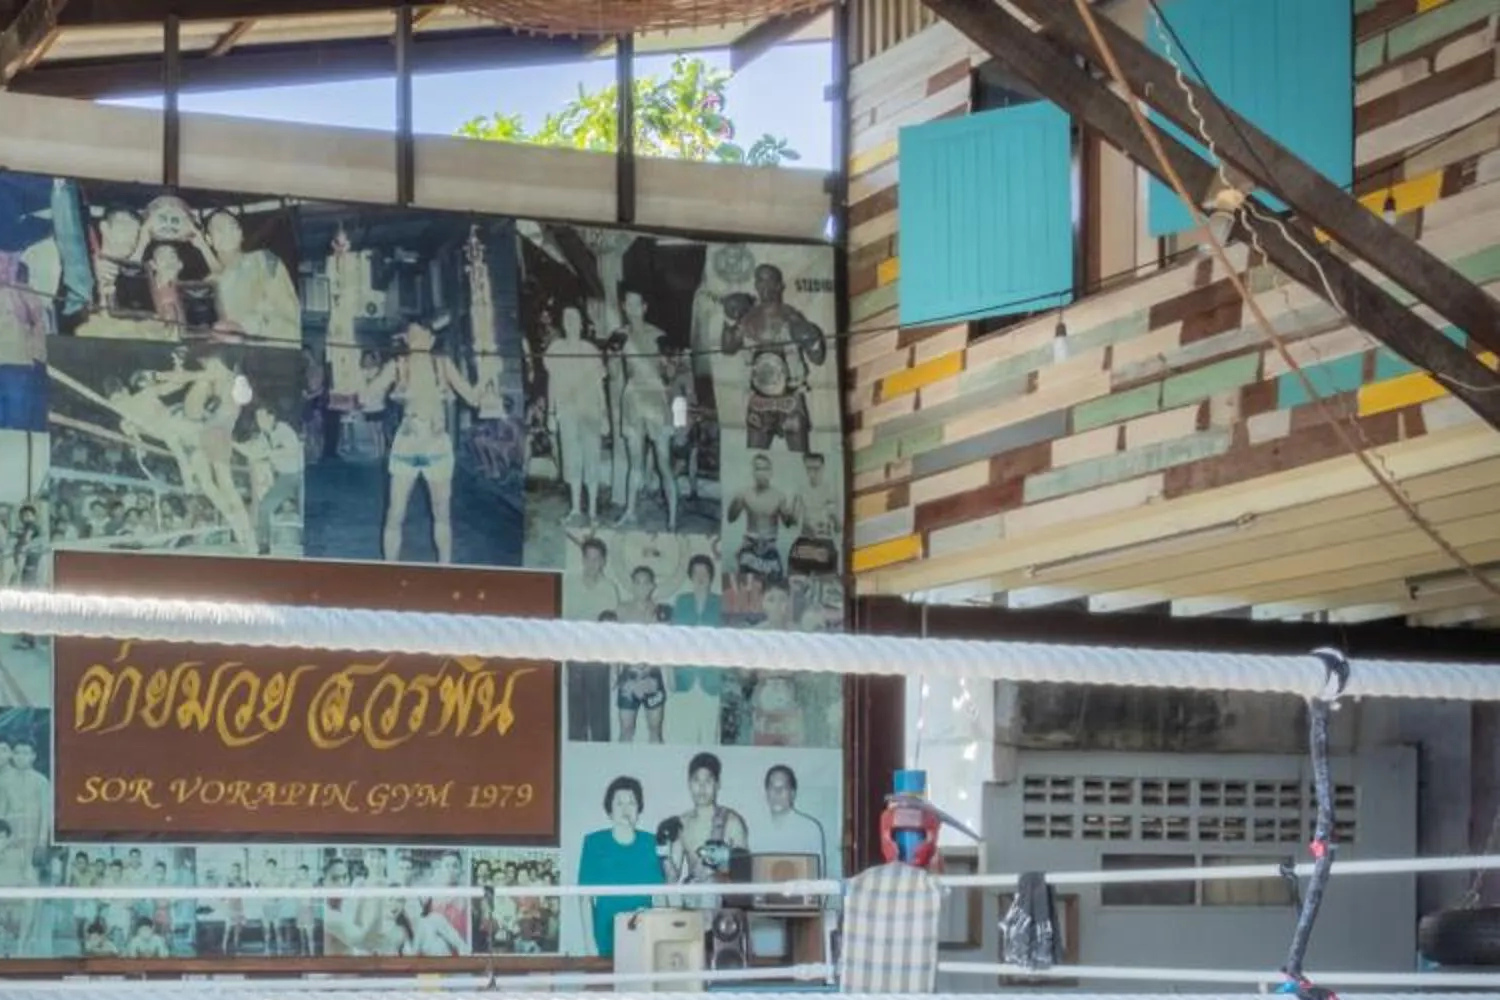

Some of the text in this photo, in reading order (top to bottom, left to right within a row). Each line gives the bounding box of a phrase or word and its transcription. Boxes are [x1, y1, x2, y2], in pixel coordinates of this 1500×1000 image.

[76, 776, 533, 815] SOR VORAPIN GYM 1979
